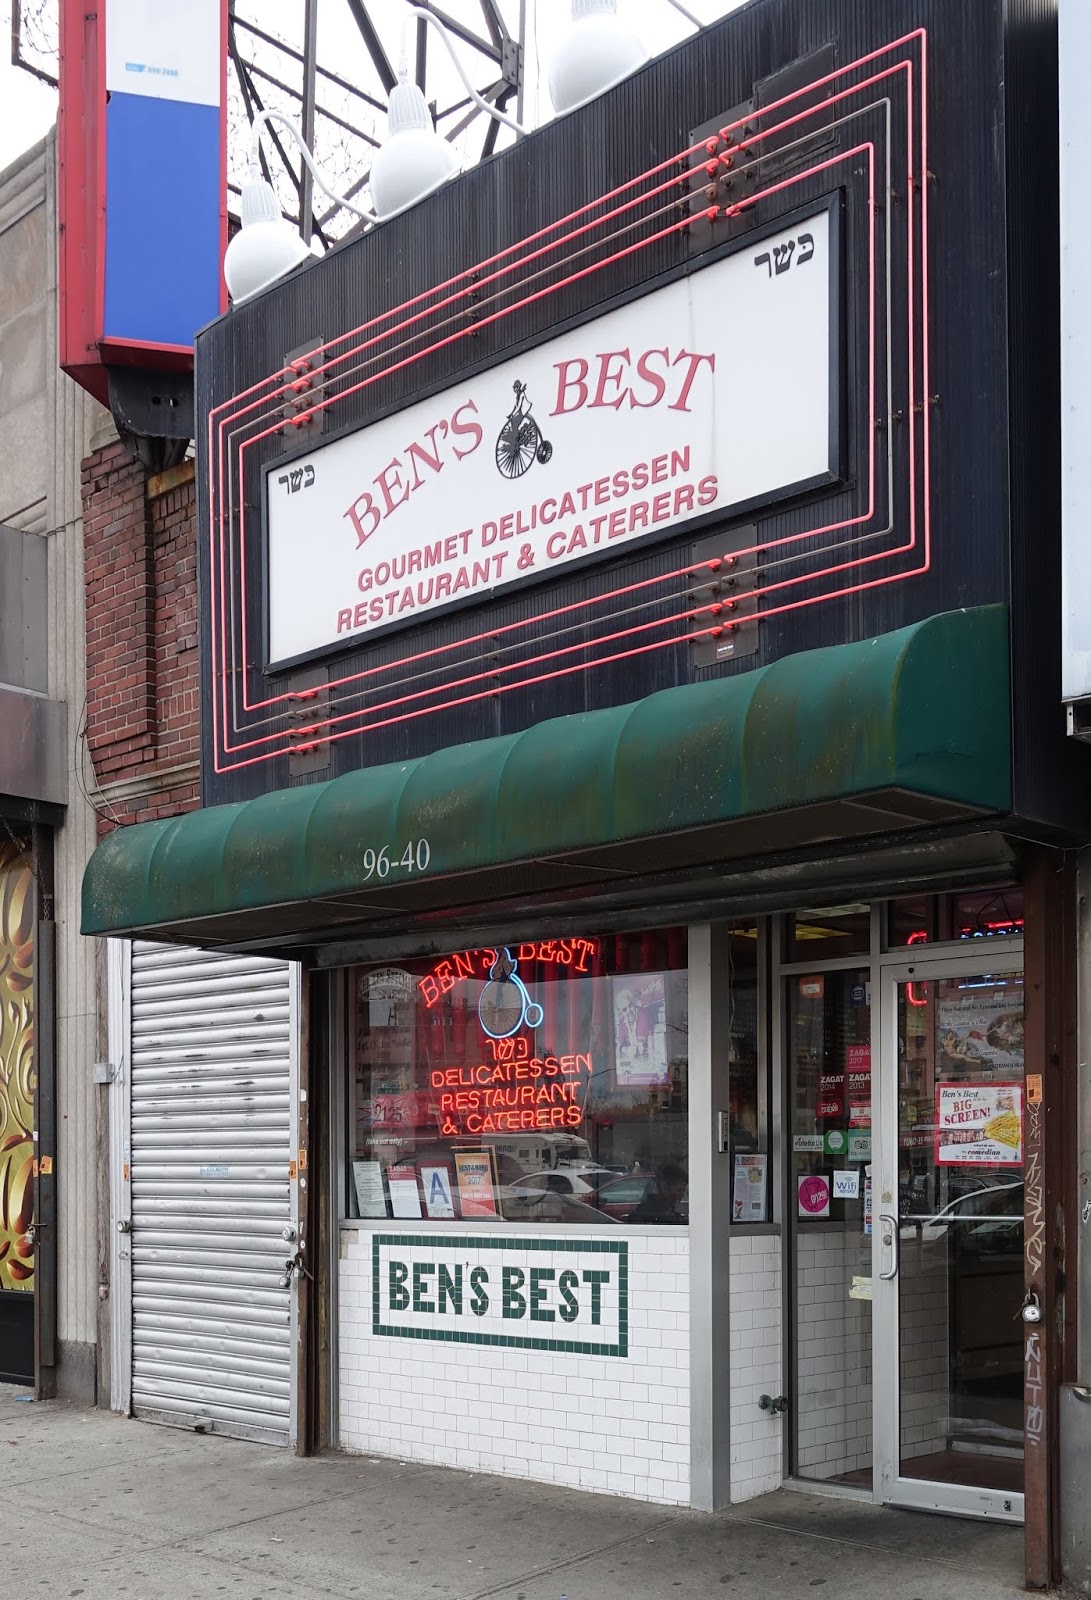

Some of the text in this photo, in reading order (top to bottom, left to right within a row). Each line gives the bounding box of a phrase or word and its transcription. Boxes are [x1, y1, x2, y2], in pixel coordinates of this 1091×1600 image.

[343, 348, 715, 549] BEN'S BEST
[358, 446, 691, 592] GOURMET DELICATESSEN
[337, 475, 718, 634] RESTAURANT & CATERERS
[363, 838, 430, 880] 96-40
[849, 1049, 871, 1057] ZAGA
[431, 1053, 593, 1088] DELICATESSEN
[820, 1075, 845, 1084] ZAGAT
[441, 1081, 581, 1111] RESTAURANT
[848, 1082, 865, 1090] 2013
[942, 1090, 979, 1098] Ben's Best
[944, 1107, 991, 1125] SCREEN!
[953, 1099, 972, 1112] BIG
[442, 1106, 582, 1134] & CATERERS
[967, 1148, 1001, 1156] comedian
[430, 1172, 449, 1204] A
[468, 1176, 481, 1185] 2017
[836, 1181, 857, 1190] Wifi
[389, 1261, 610, 1325] BEN'S BEST
